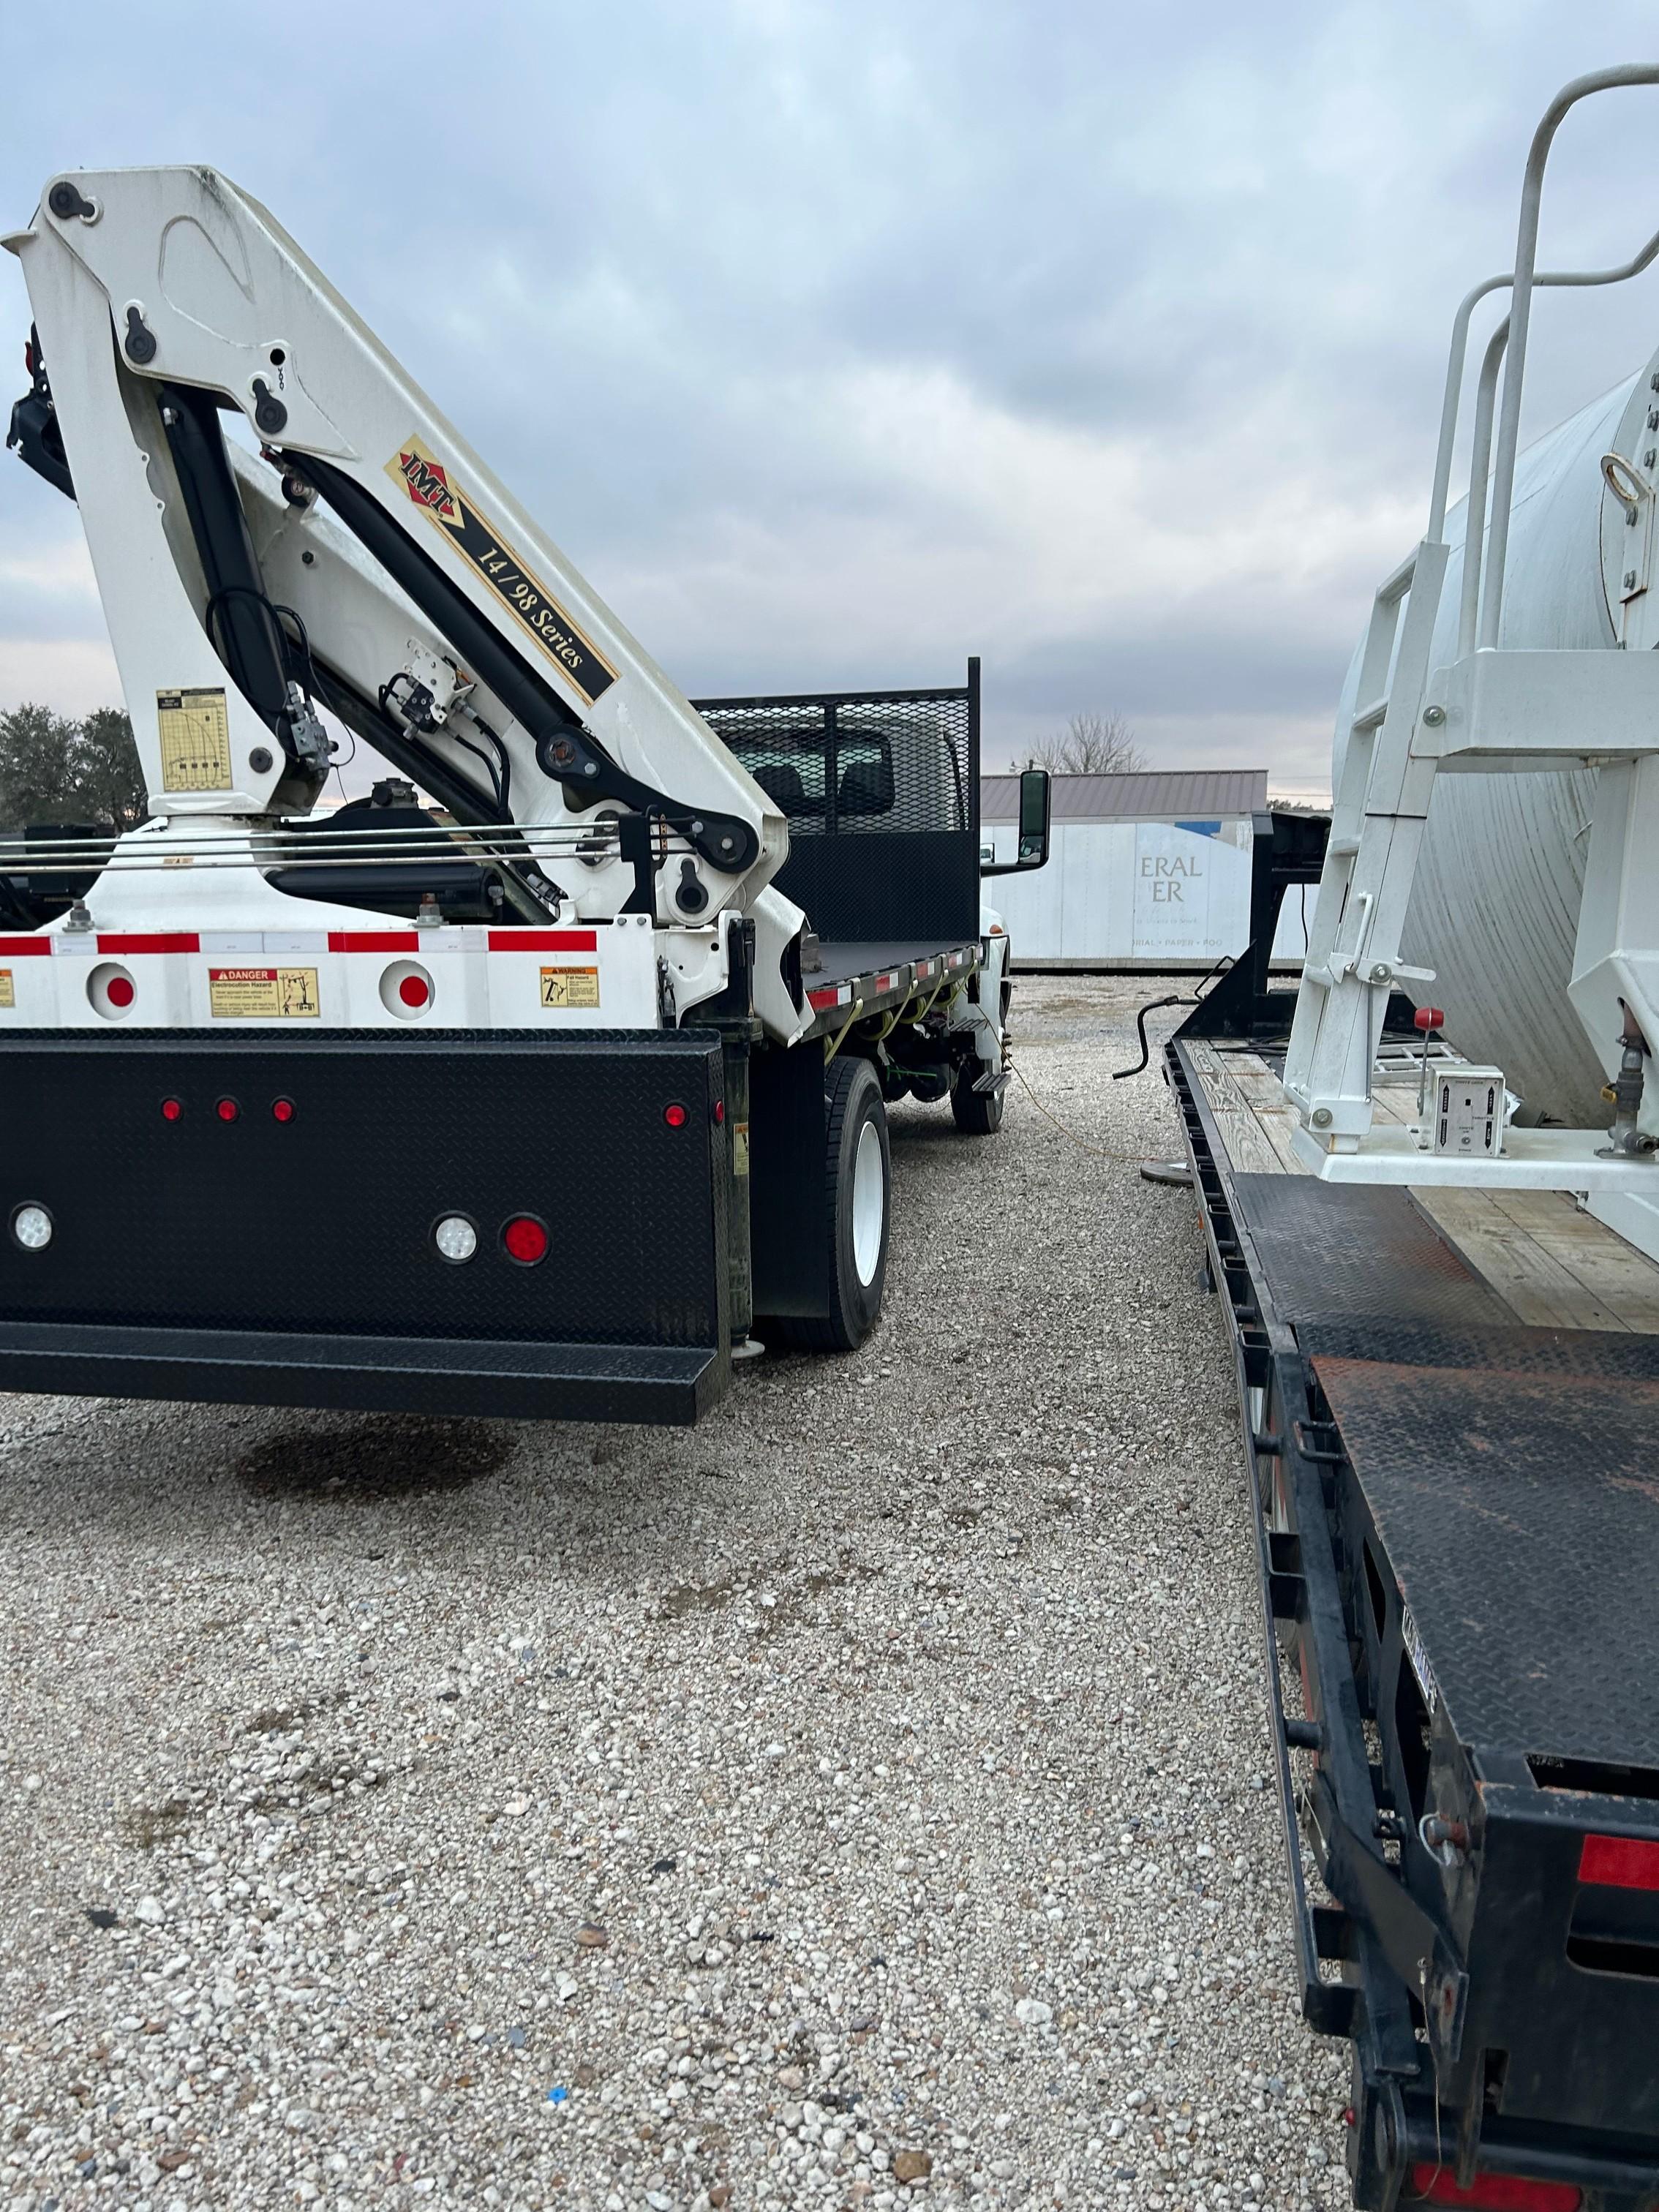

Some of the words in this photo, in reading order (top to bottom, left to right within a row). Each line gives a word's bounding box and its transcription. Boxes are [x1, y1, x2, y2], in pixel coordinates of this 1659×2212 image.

[399, 451, 456, 514] IMT
[530, 609, 583, 668] Series
[1141, 857, 1203, 877] ERAL
[229, 971, 268, 980] DANGER
